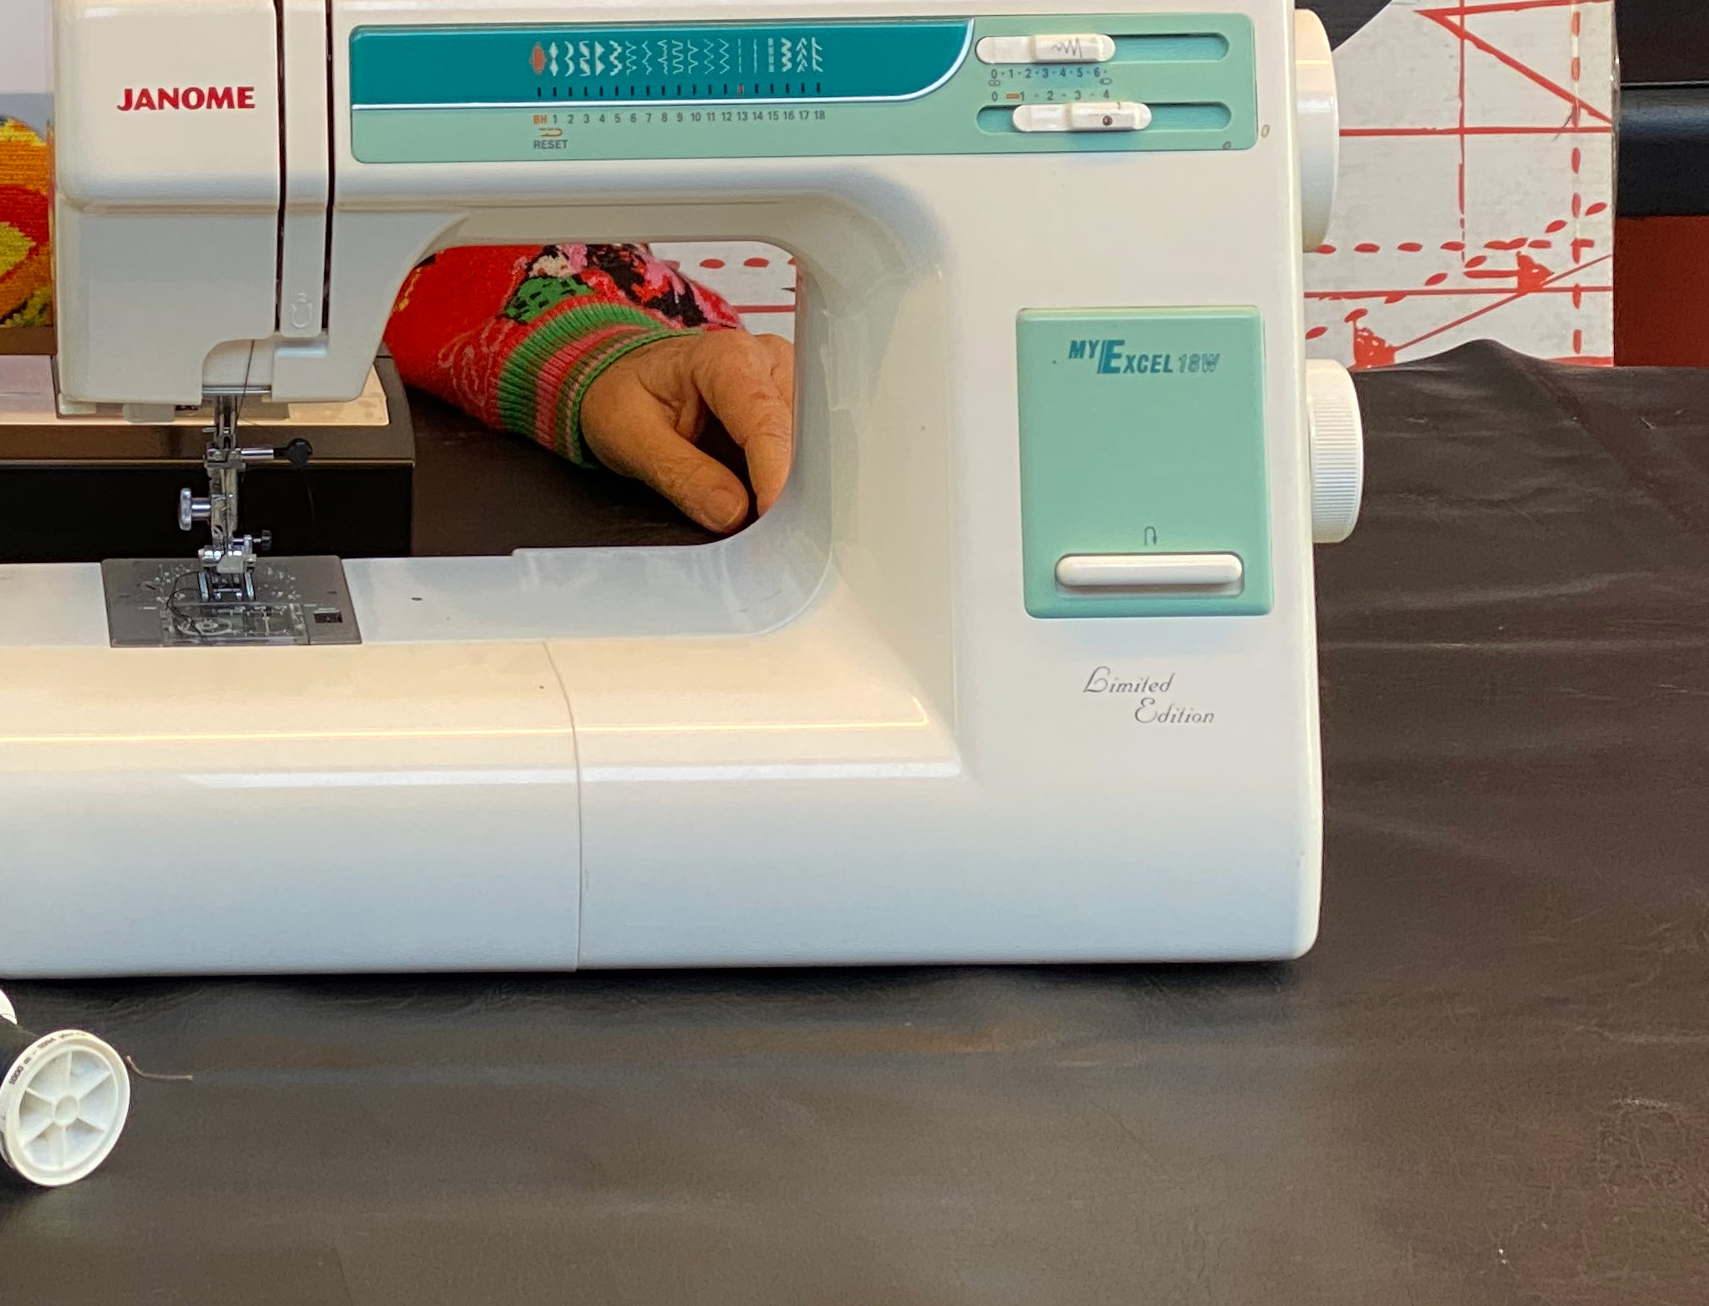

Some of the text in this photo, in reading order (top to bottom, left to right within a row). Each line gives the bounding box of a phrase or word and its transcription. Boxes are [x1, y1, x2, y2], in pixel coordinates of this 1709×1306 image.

[115, 85, 256, 112] JANOME
[567, 113, 574, 124] 2
[583, 113, 590, 124] 3
[598, 113, 606, 124] 4
[614, 113, 621, 124] 5
[630, 112, 637, 123] 6
[645, 112, 652, 123] 7
[661, 112, 668, 123] 8
[676, 112, 683, 123] 9
[533, 139, 569, 150] RESET
[1068, 339, 1100, 360] MY
[1178, 352, 1221, 374] 18W
[1082, 665, 1175, 695] Limited
[1133, 696, 1216, 725] Edition
